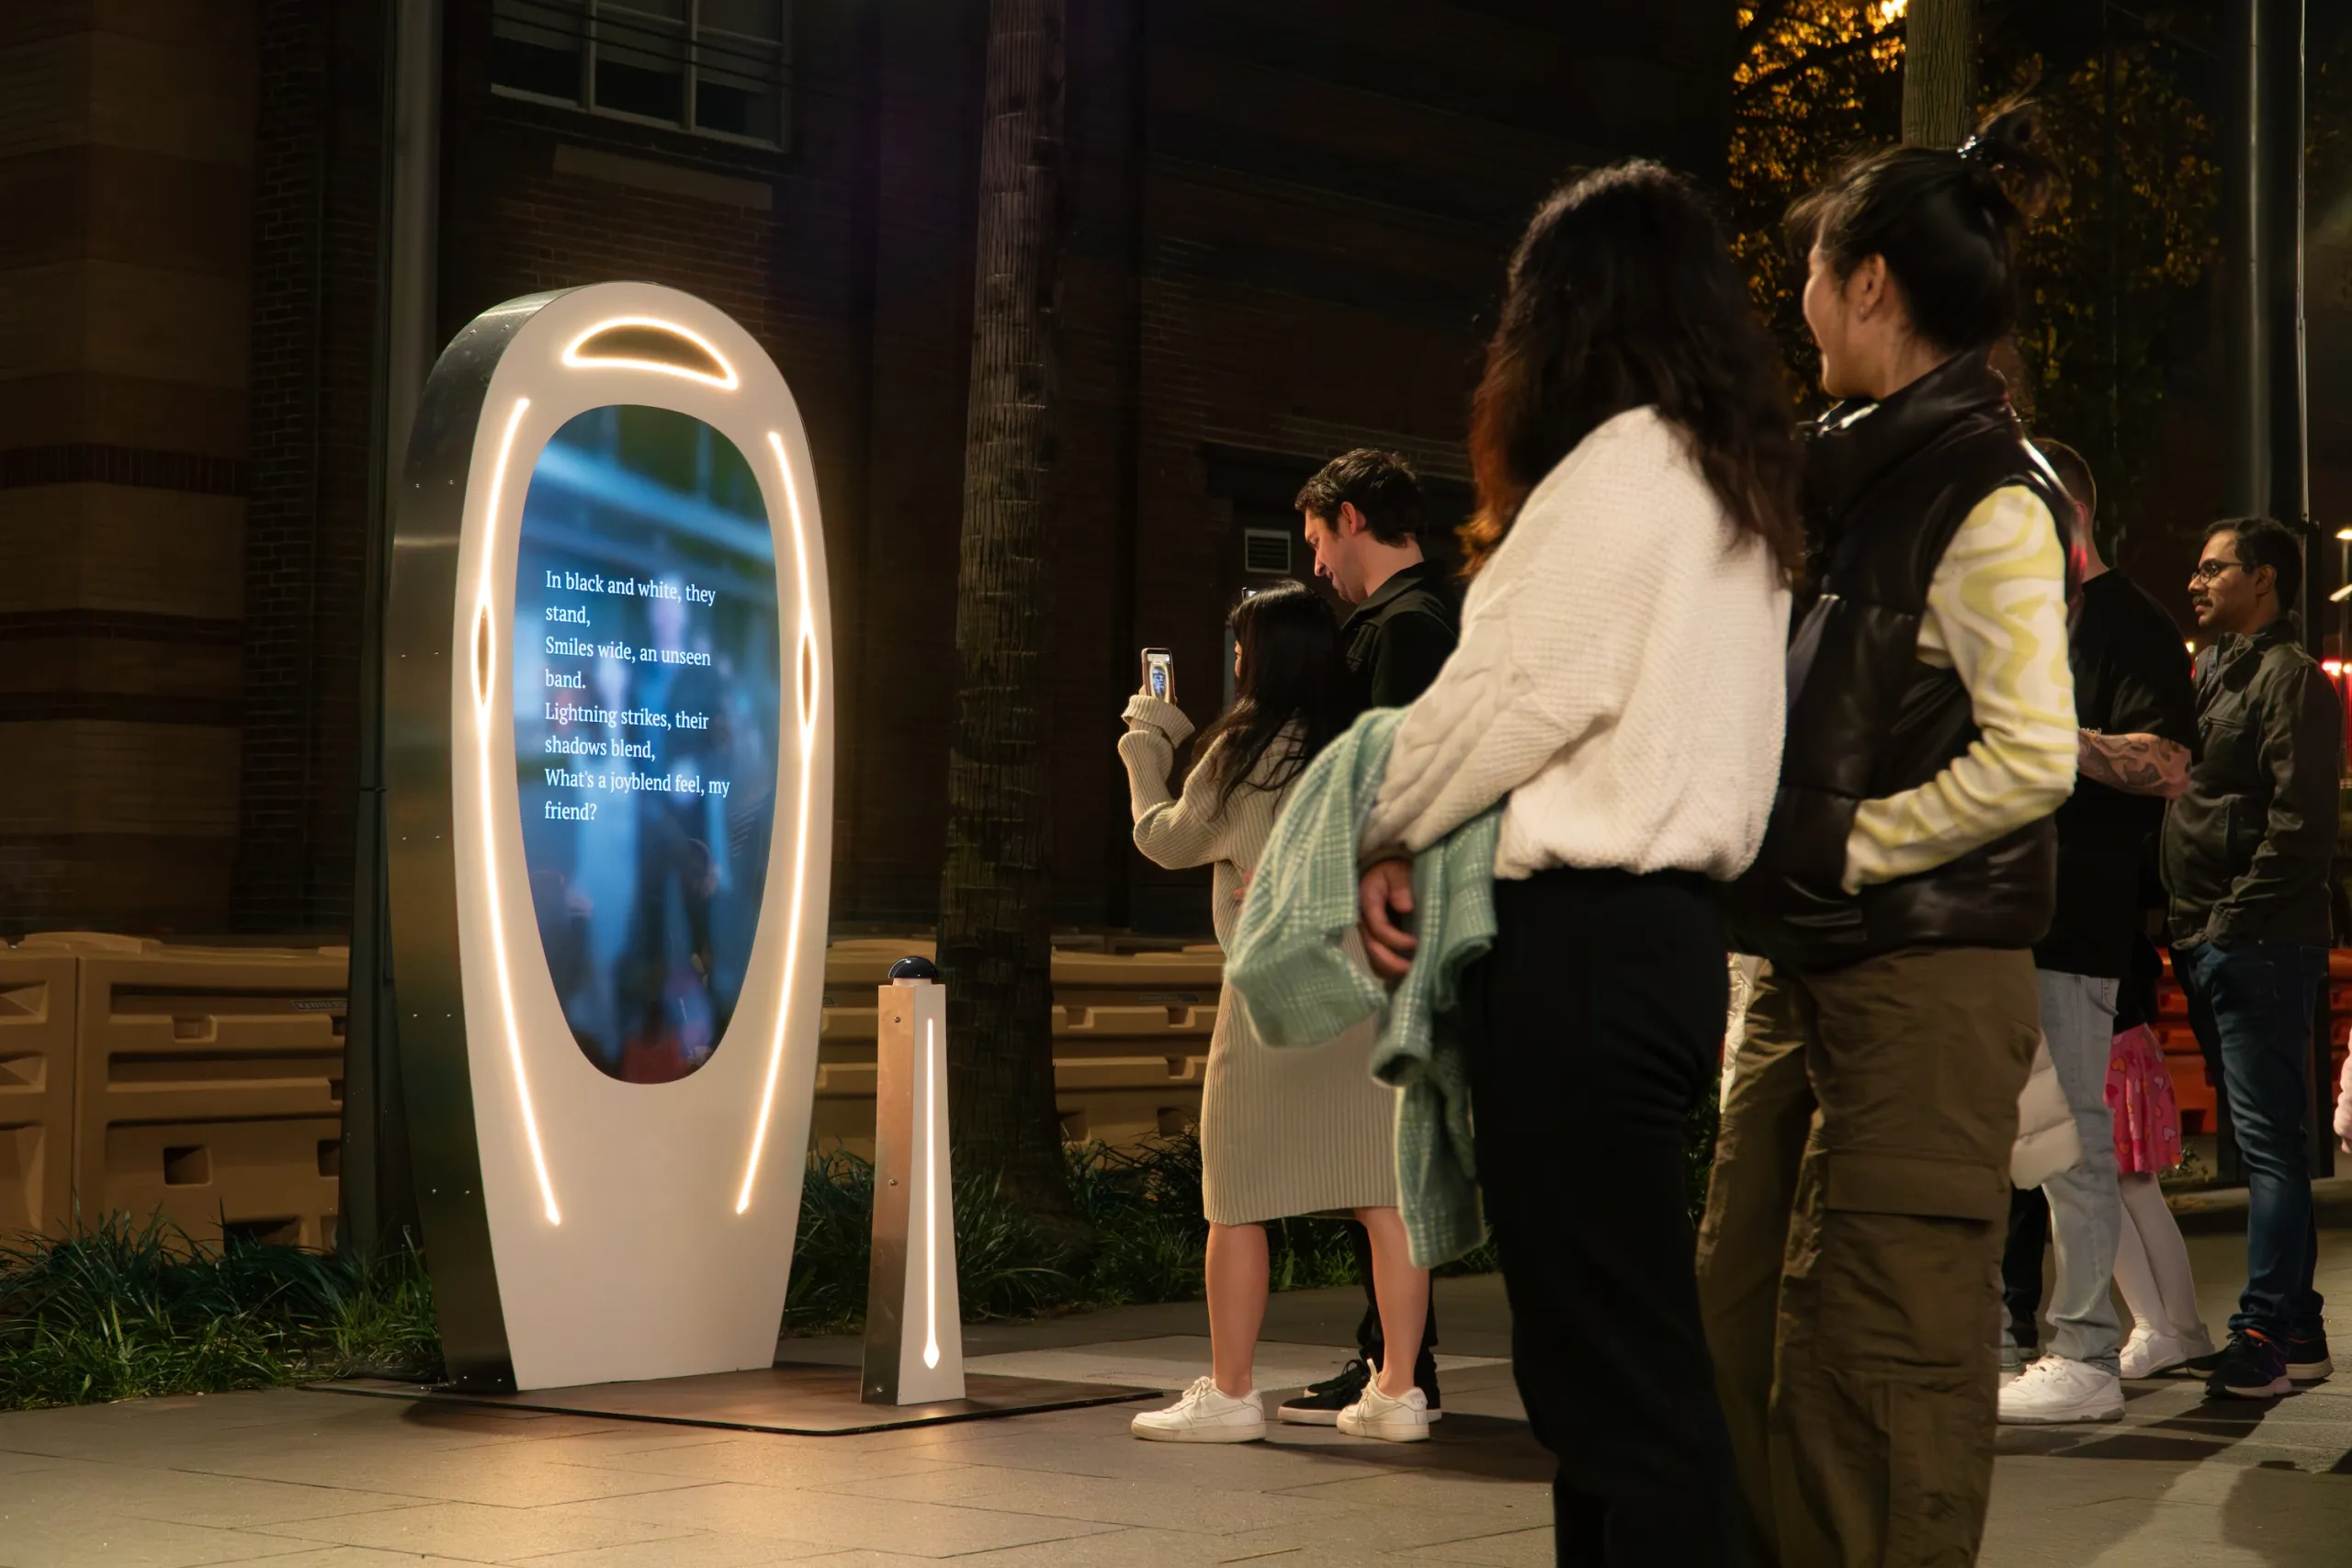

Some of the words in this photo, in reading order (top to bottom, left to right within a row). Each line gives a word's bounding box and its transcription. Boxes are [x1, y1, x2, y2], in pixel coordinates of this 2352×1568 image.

[546, 570, 561, 588] In
[565, 571, 604, 592] black
[607, 578, 635, 595] and
[638, 580, 682, 602] white,
[685, 584, 716, 606] they
[546, 605, 590, 627] stand,
[546, 637, 594, 657] Smiles
[597, 641, 636, 663] wide,
[639, 649, 657, 661] an
[662, 650, 711, 666] unseen
[546, 669, 585, 689] band.
[545, 703, 617, 728] Lightning
[621, 708, 672, 730] strikes,
[675, 711, 709, 729] their
[546, 735, 606, 756] shadows
[611, 739, 655, 761] blend,
[545, 768, 594, 787] What's
[598, 775, 607, 788] a
[610, 772, 672, 794] joyblend
[675, 774, 705, 795] feel,
[708, 781, 730, 798] my
[545, 801, 596, 820] friend?
